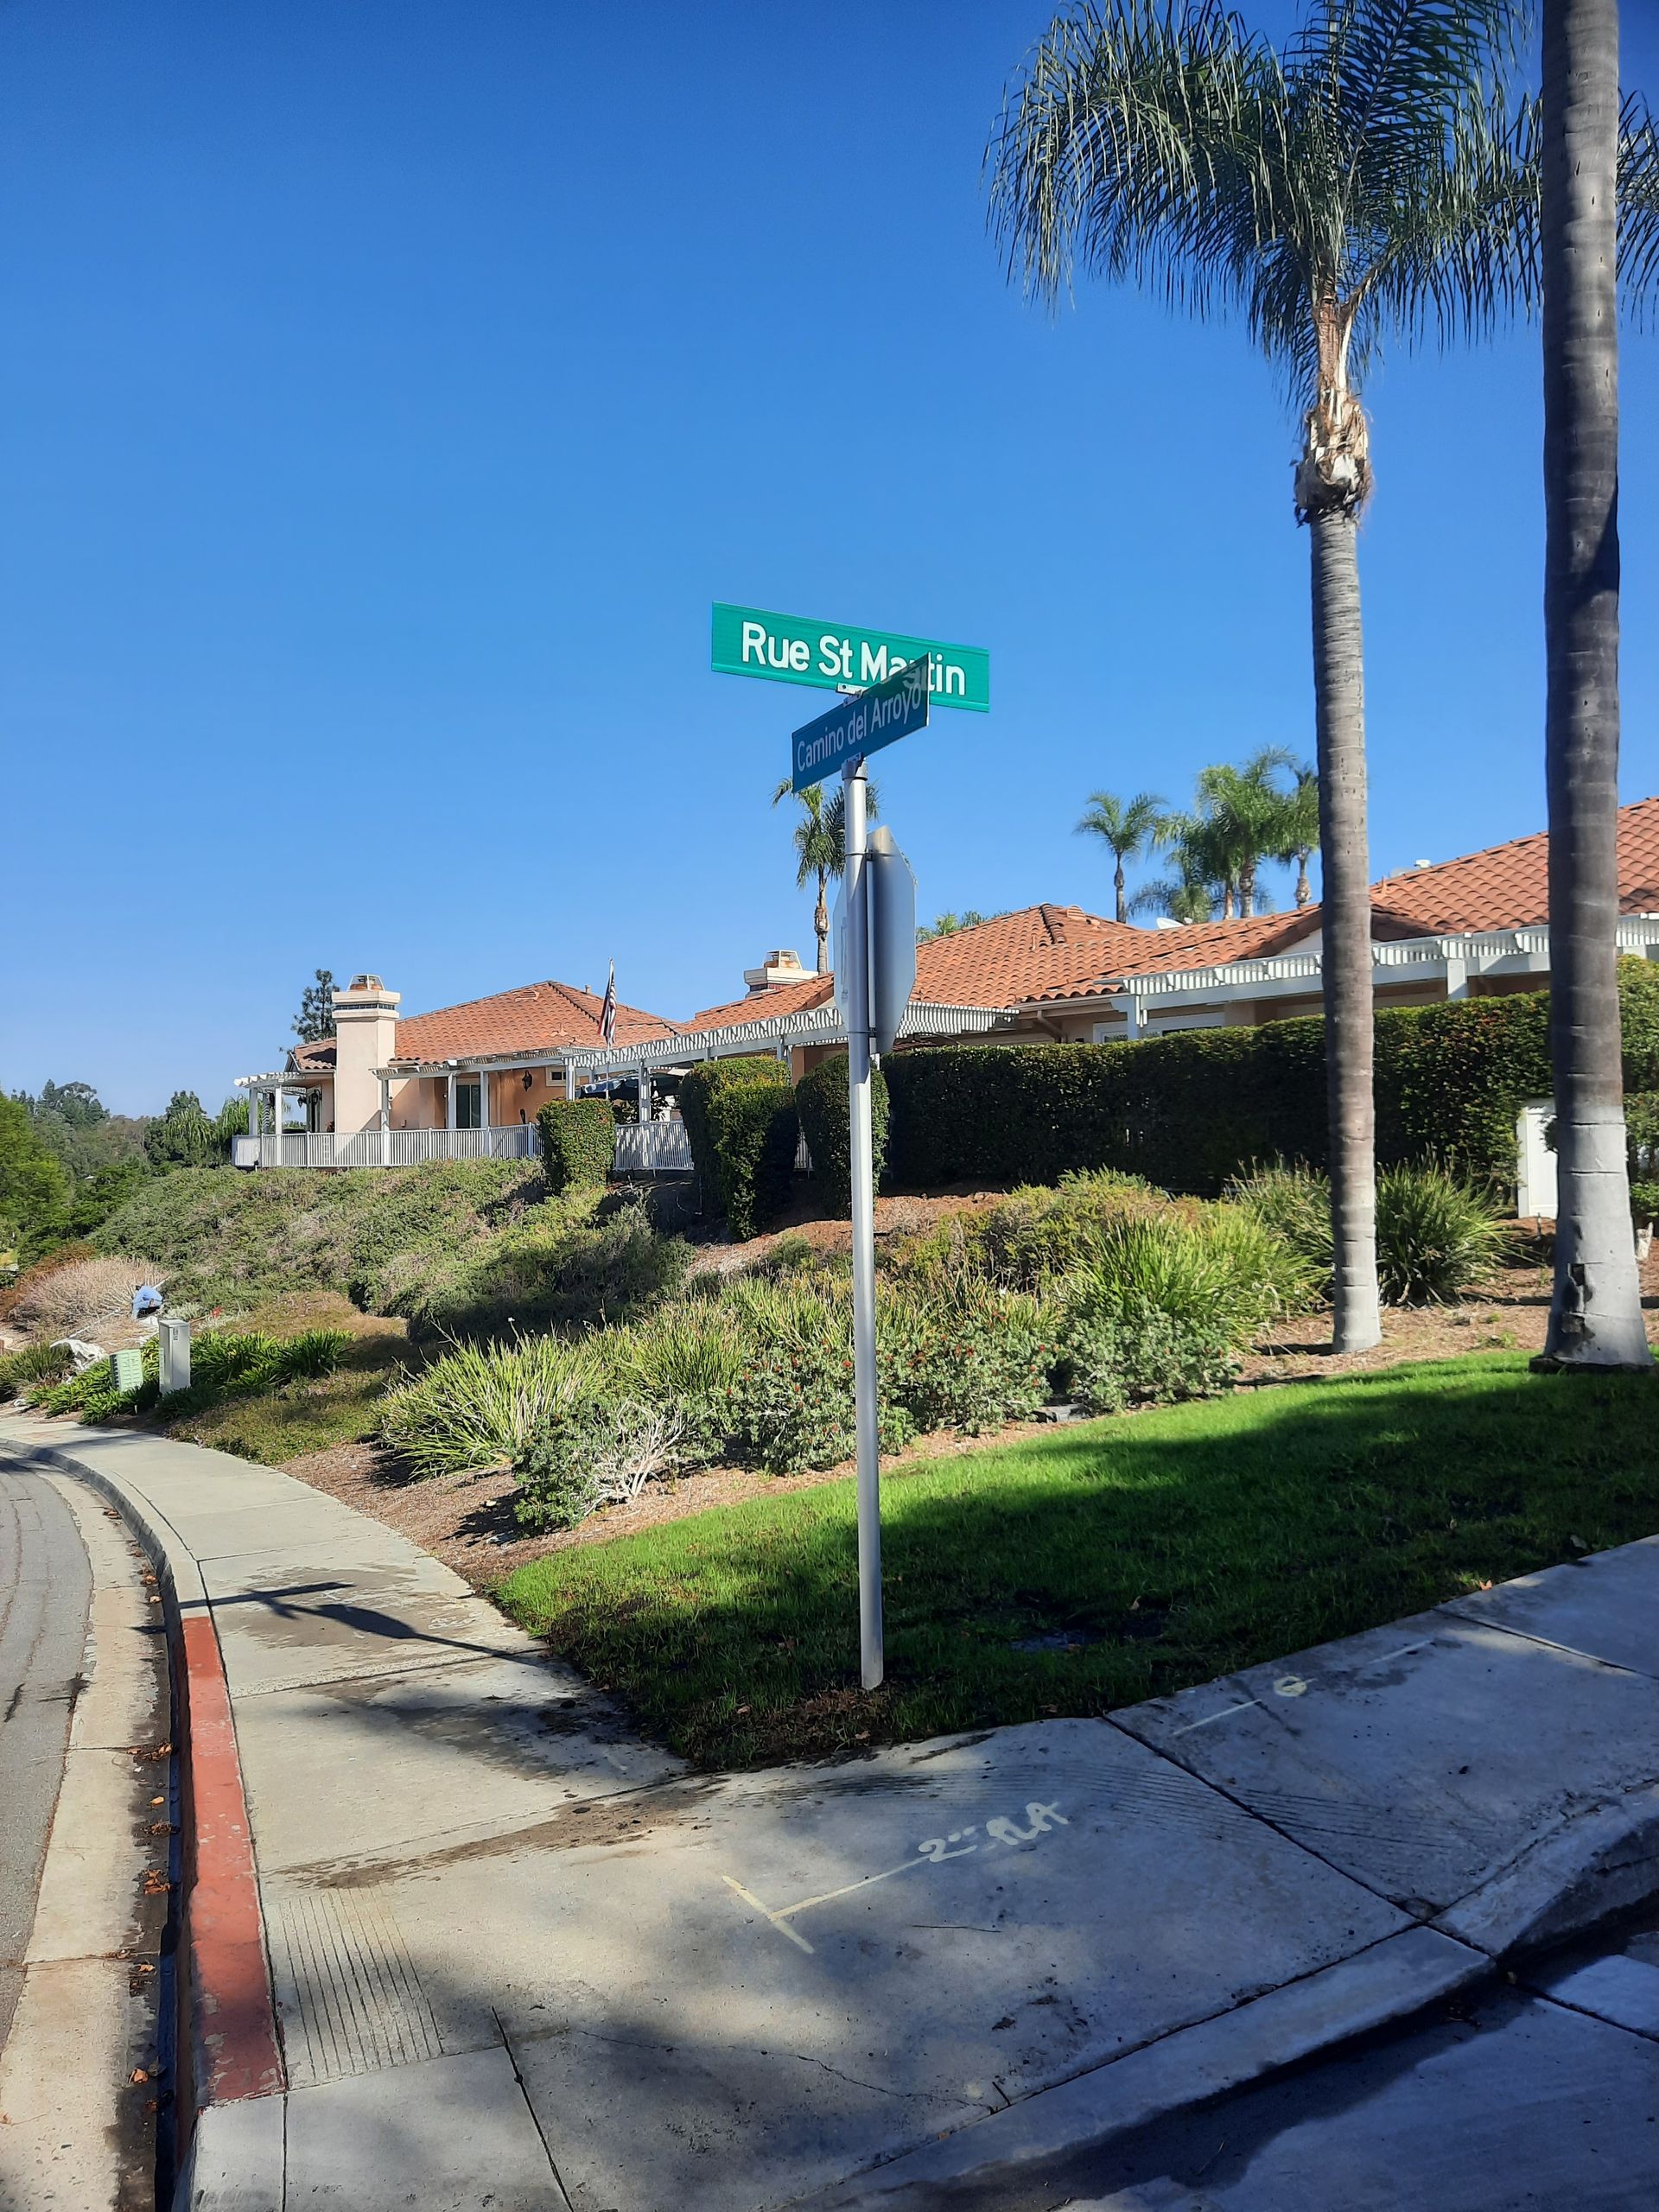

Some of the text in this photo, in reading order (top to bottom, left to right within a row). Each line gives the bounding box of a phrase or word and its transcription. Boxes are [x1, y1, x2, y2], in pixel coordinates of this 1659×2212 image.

[742, 620, 966, 696] Rue St Matin
[797, 682, 922, 772] Camino del Arroyo
